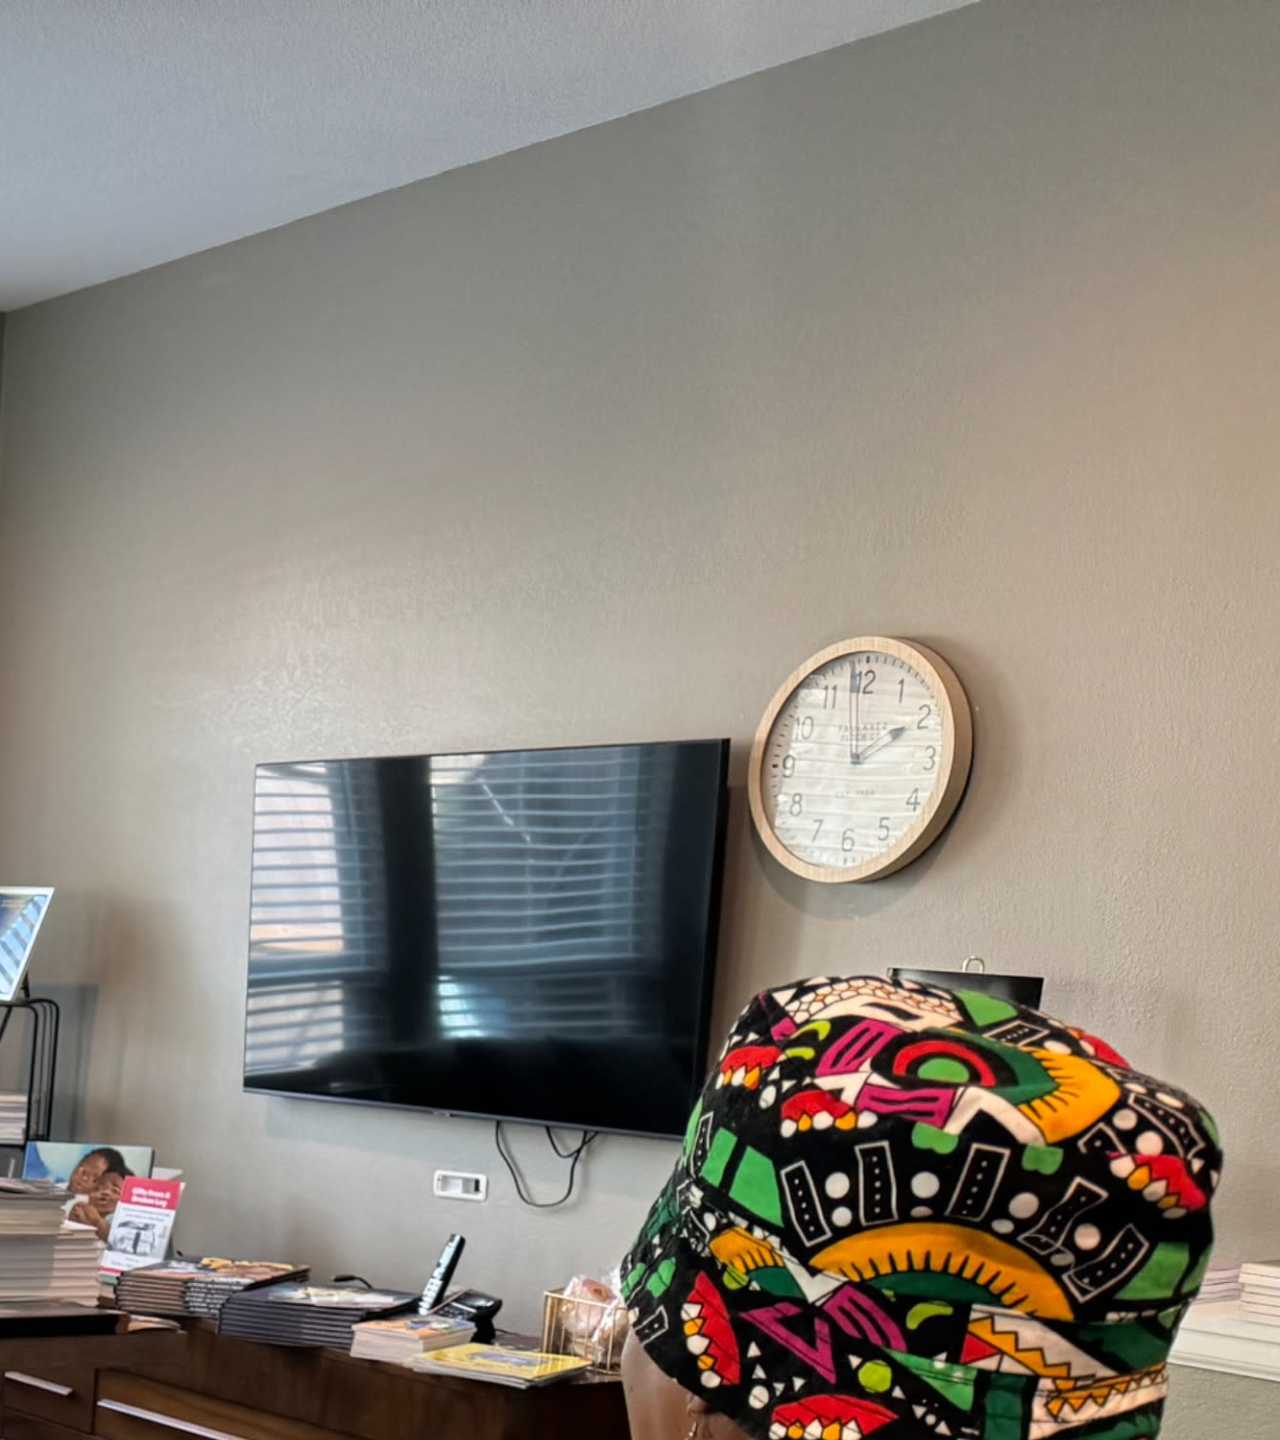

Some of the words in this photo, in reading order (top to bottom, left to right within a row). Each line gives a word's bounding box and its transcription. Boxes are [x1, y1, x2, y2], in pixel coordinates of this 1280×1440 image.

[823, 685, 837, 709] 11
[898, 678, 905, 703] 1
[795, 716, 814, 741] 10
[917, 704, 931, 729] 2
[782, 755, 796, 778] 9
[923, 745, 936, 771] 3
[790, 793, 802, 816] 8
[906, 787, 920, 812] 4
[812, 819, 823, 842] 7
[842, 828, 855, 851] 6
[878, 817, 890, 841] 5
